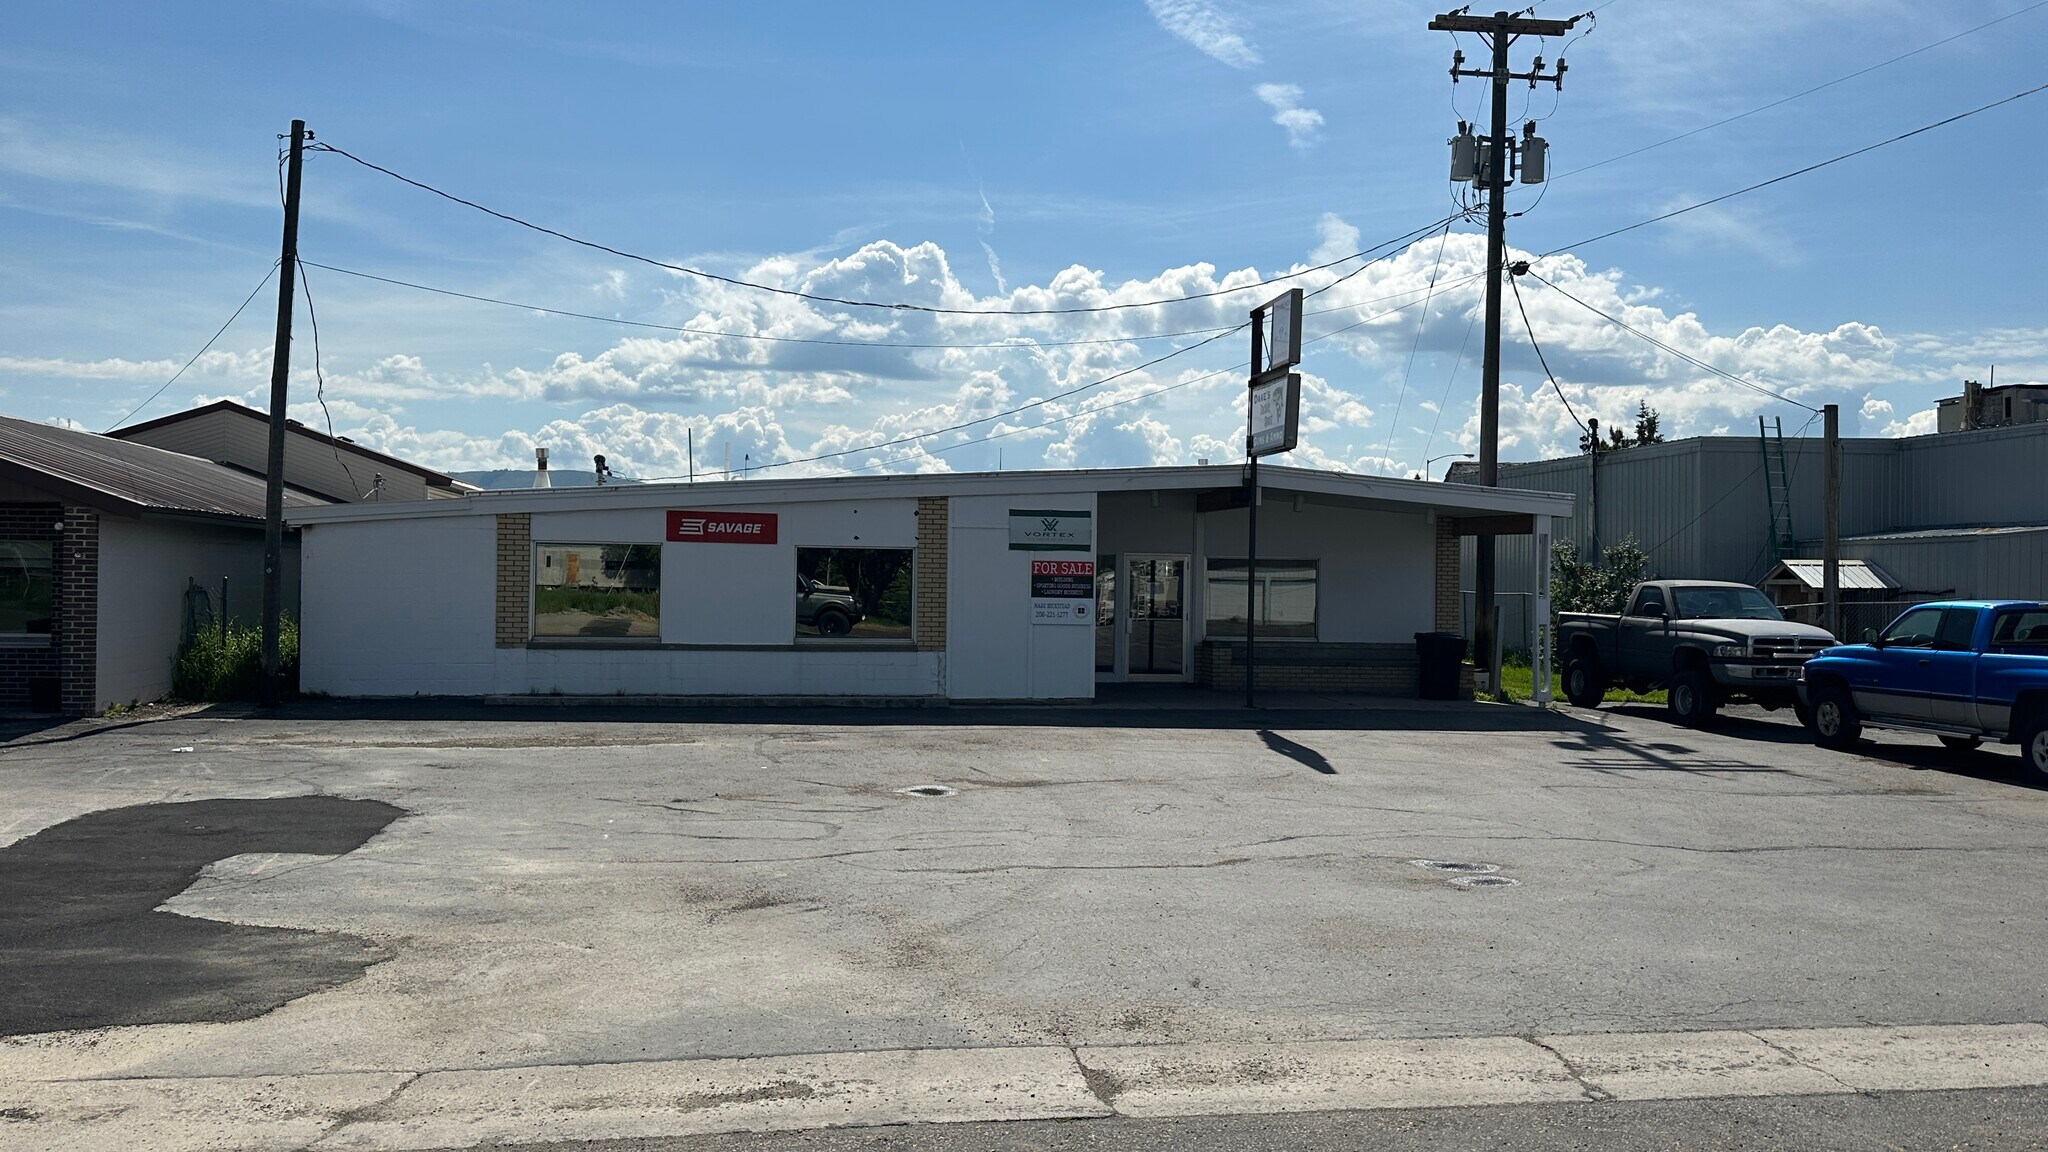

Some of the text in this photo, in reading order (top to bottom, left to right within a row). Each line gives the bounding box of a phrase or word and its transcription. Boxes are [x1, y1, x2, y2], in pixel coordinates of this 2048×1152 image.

[707, 522, 762, 534] SAVAGE
[1033, 562, 1093, 575] FOR SALE
